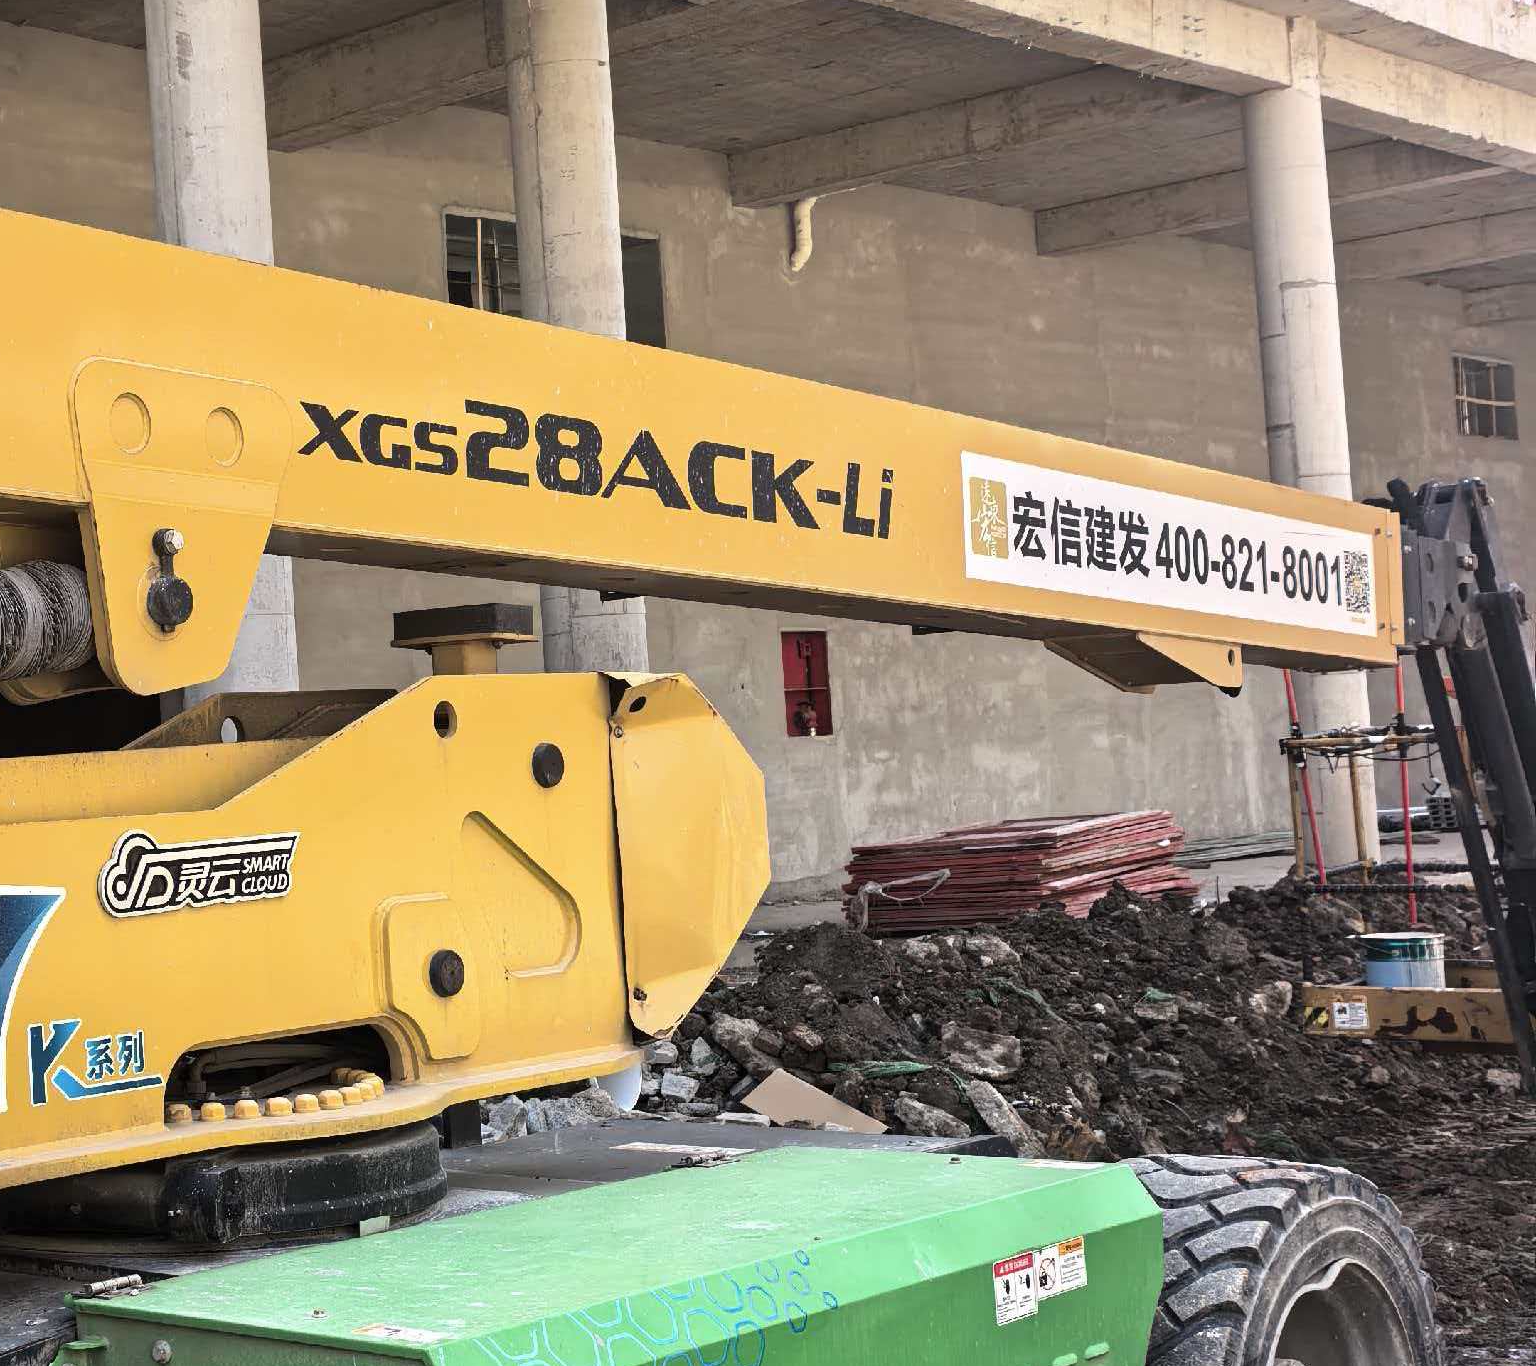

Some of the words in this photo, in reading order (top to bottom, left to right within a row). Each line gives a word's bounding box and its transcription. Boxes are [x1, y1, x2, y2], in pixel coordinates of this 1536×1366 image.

[297, 397, 894, 540] XGS28ACK-Li
[1011, 490, 1151, 579] 宏信建发
[1154, 521, 1343, 608] 400-821-8001
[175, 857, 242, 902] 灵云
[241, 872, 289, 894] CLOUD
[242, 852, 290, 875] SMART
